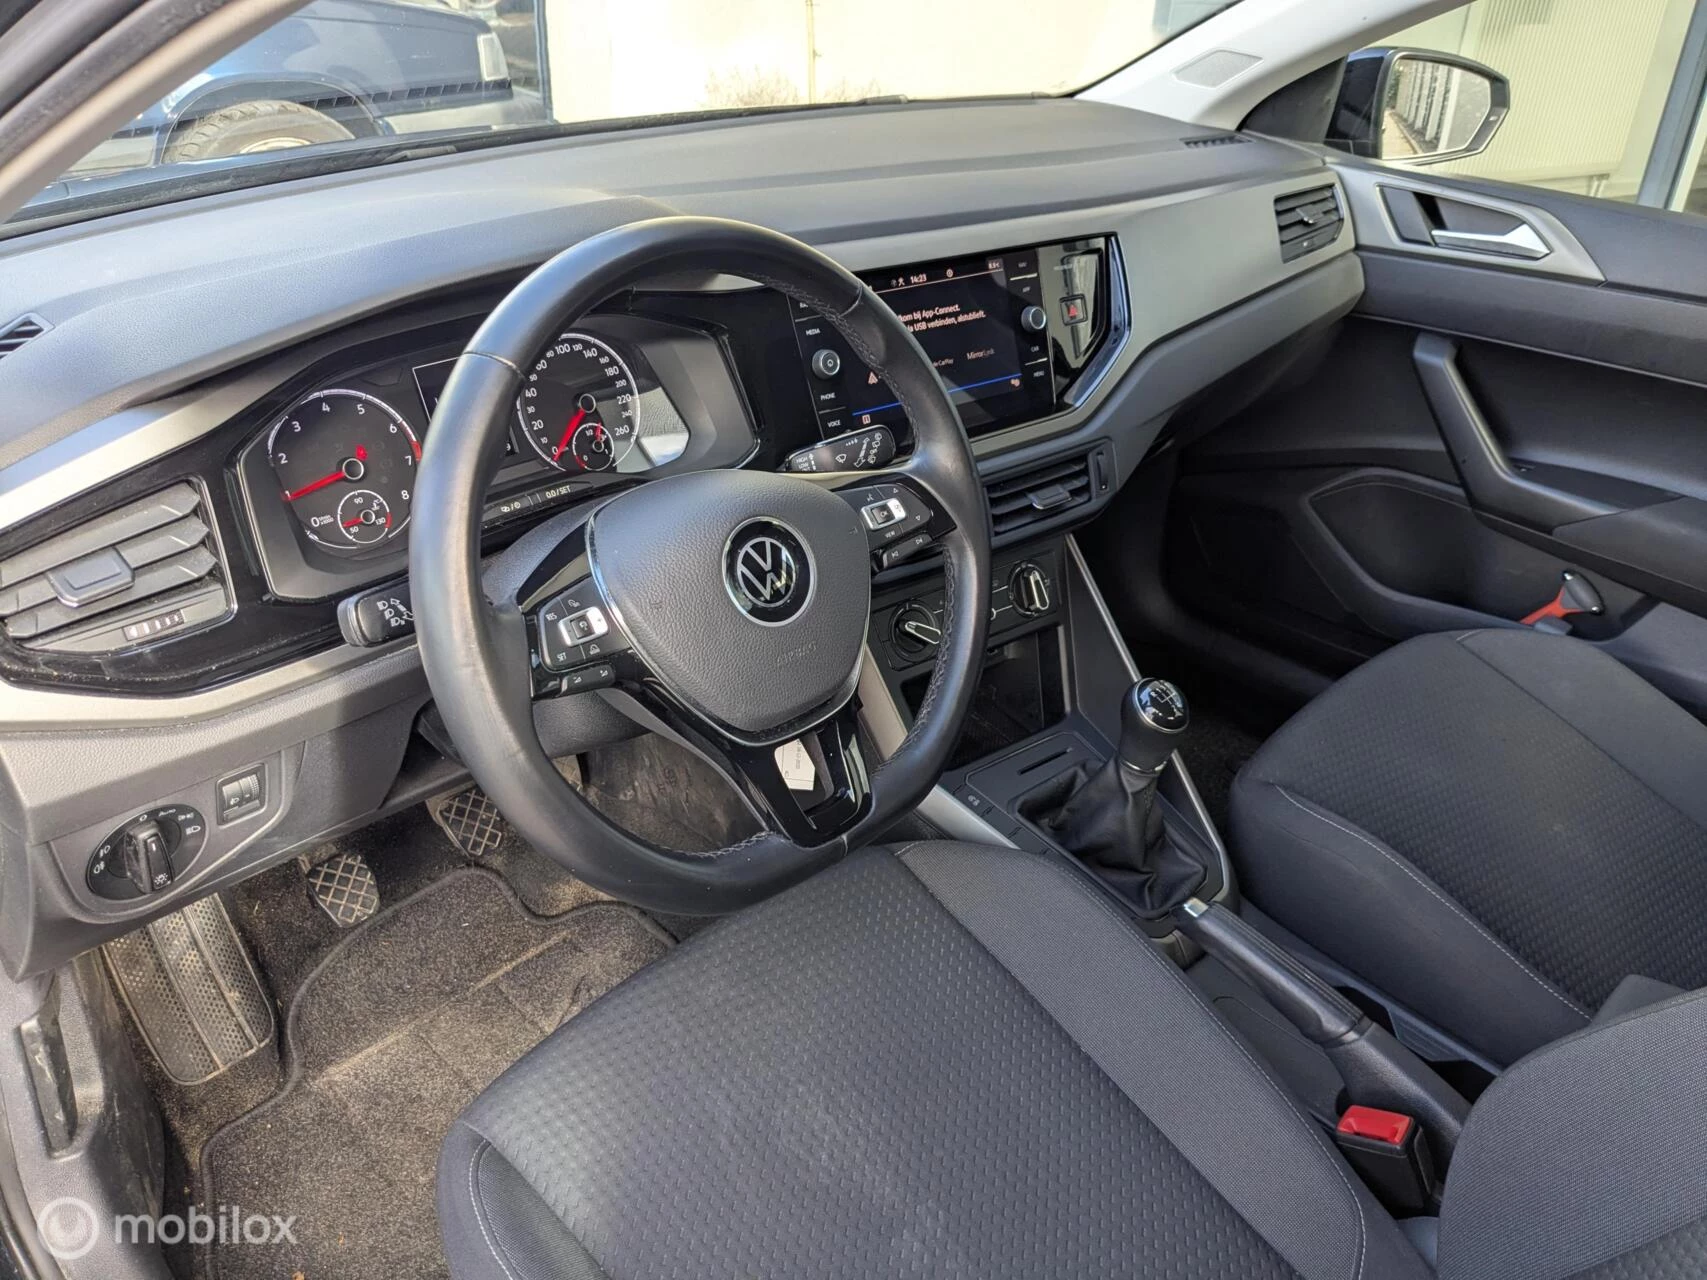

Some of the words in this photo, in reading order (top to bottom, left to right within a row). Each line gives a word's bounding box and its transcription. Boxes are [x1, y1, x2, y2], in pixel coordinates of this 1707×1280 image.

[910, 274, 927, 284] 14:23
[913, 310, 922, 320] bij
[914, 321, 927, 331] USB
[805, 328, 821, 336] MEDIA
[555, 343, 571, 355] 100
[572, 343, 583, 352] 120
[583, 347, 598, 359] 140
[599, 356, 610, 364] 160
[605, 366, 619, 377] 180
[529, 374, 538, 382] 50
[615, 379, 627, 388] 200
[525, 387, 537, 398] 40
[820, 392, 836, 401] PHONE
[617, 393, 632, 405] 220
[322, 402, 330, 412] 4
[357, 404, 365, 415] 5
[526, 406, 535, 414] 30
[621, 410, 633, 418] 240
[292, 421, 301, 432] 3
[389, 424, 397, 433] 6
[531, 419, 544, 431] 20
[827, 419, 841, 428] VOICE
[614, 425, 630, 436] 260
[540, 436, 548, 445] 10
[278, 453, 288, 464] 2
[405, 455, 412, 466] 7
[401, 490, 409, 500] 8
[354, 497, 364, 505] 90
[311, 516, 320, 527] 0
[375, 517, 386, 526] 130
[350, 526, 359, 534] 50
[884, 530, 896, 539] VIEW
[545, 612, 558, 622] RES
[556, 652, 567, 662] SET
